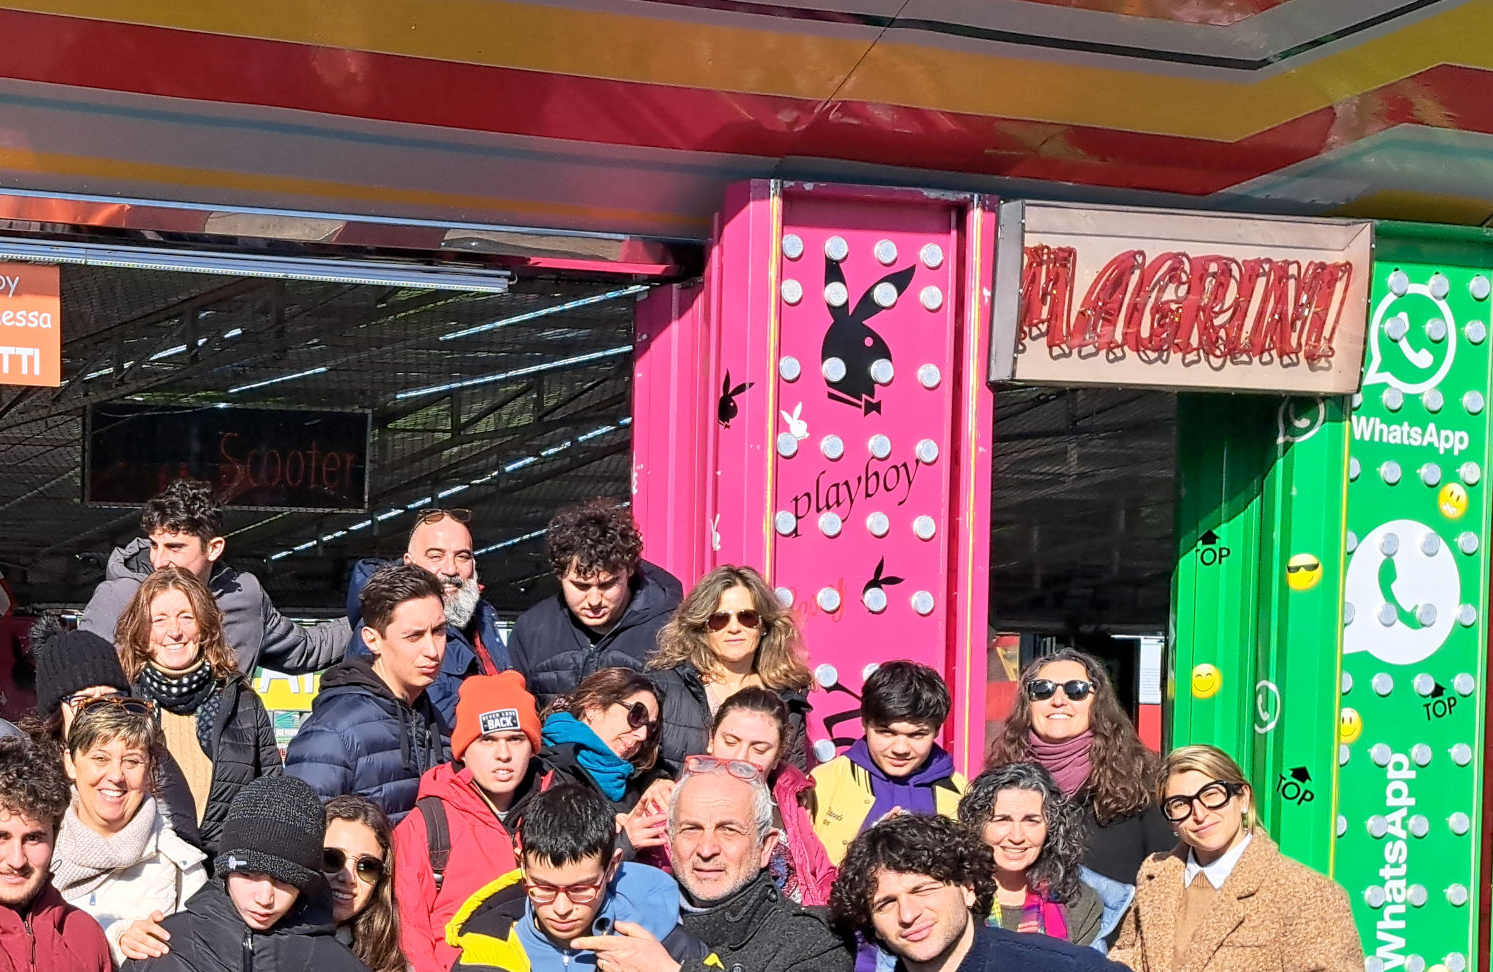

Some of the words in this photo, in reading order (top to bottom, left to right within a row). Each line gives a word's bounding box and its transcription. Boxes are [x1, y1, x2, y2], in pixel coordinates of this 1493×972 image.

[1350, 415, 1470, 456] WhatsApp
[219, 431, 358, 491] Scooter
[790, 456, 922, 539] playboy
[487, 716, 514, 730] BACK
[1423, 696, 1458, 721] TOP
[1276, 773, 1315, 806] TOP
[1376, 752, 1417, 972] WhatsApp
